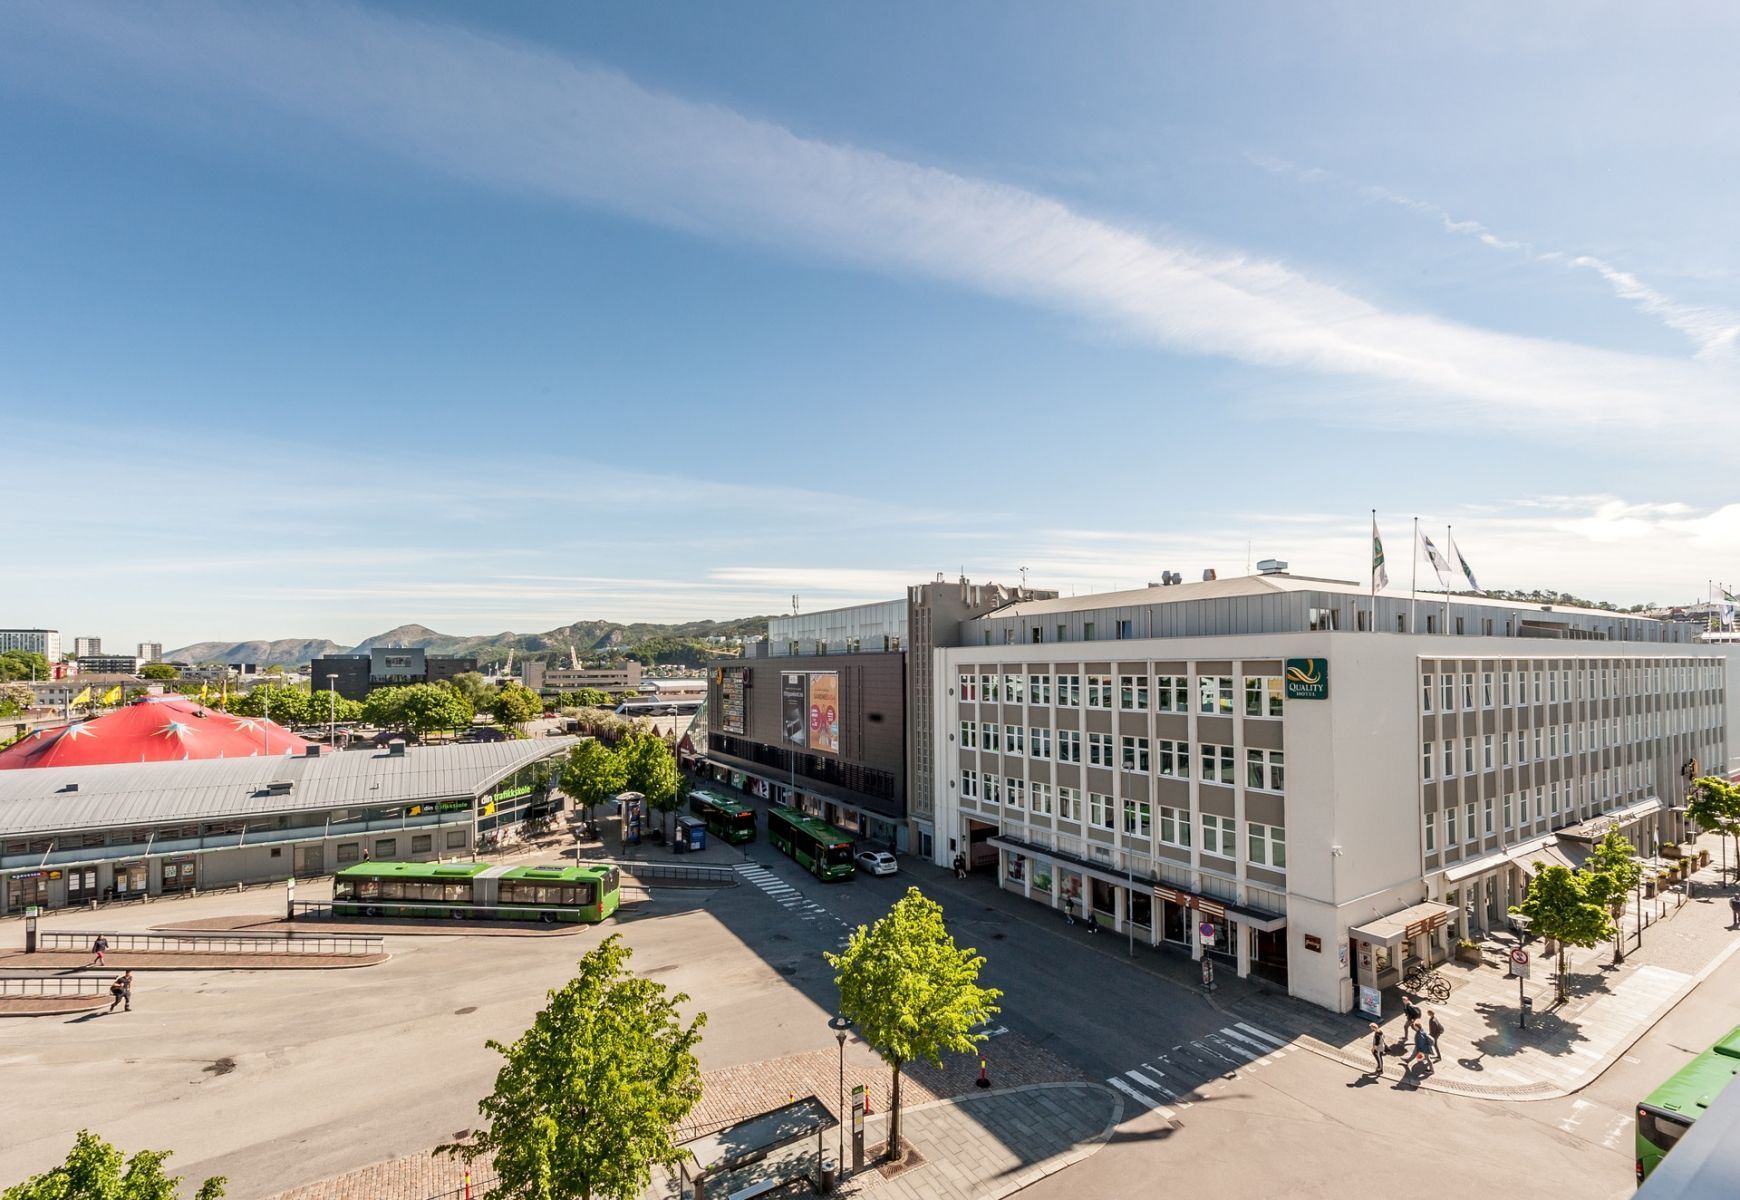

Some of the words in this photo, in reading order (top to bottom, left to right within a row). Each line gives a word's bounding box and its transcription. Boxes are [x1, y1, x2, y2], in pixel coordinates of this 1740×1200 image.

[1289, 683, 1323, 692] QUALITY
[481, 794, 493, 804] din
[494, 787, 530, 801] trafikkskole
